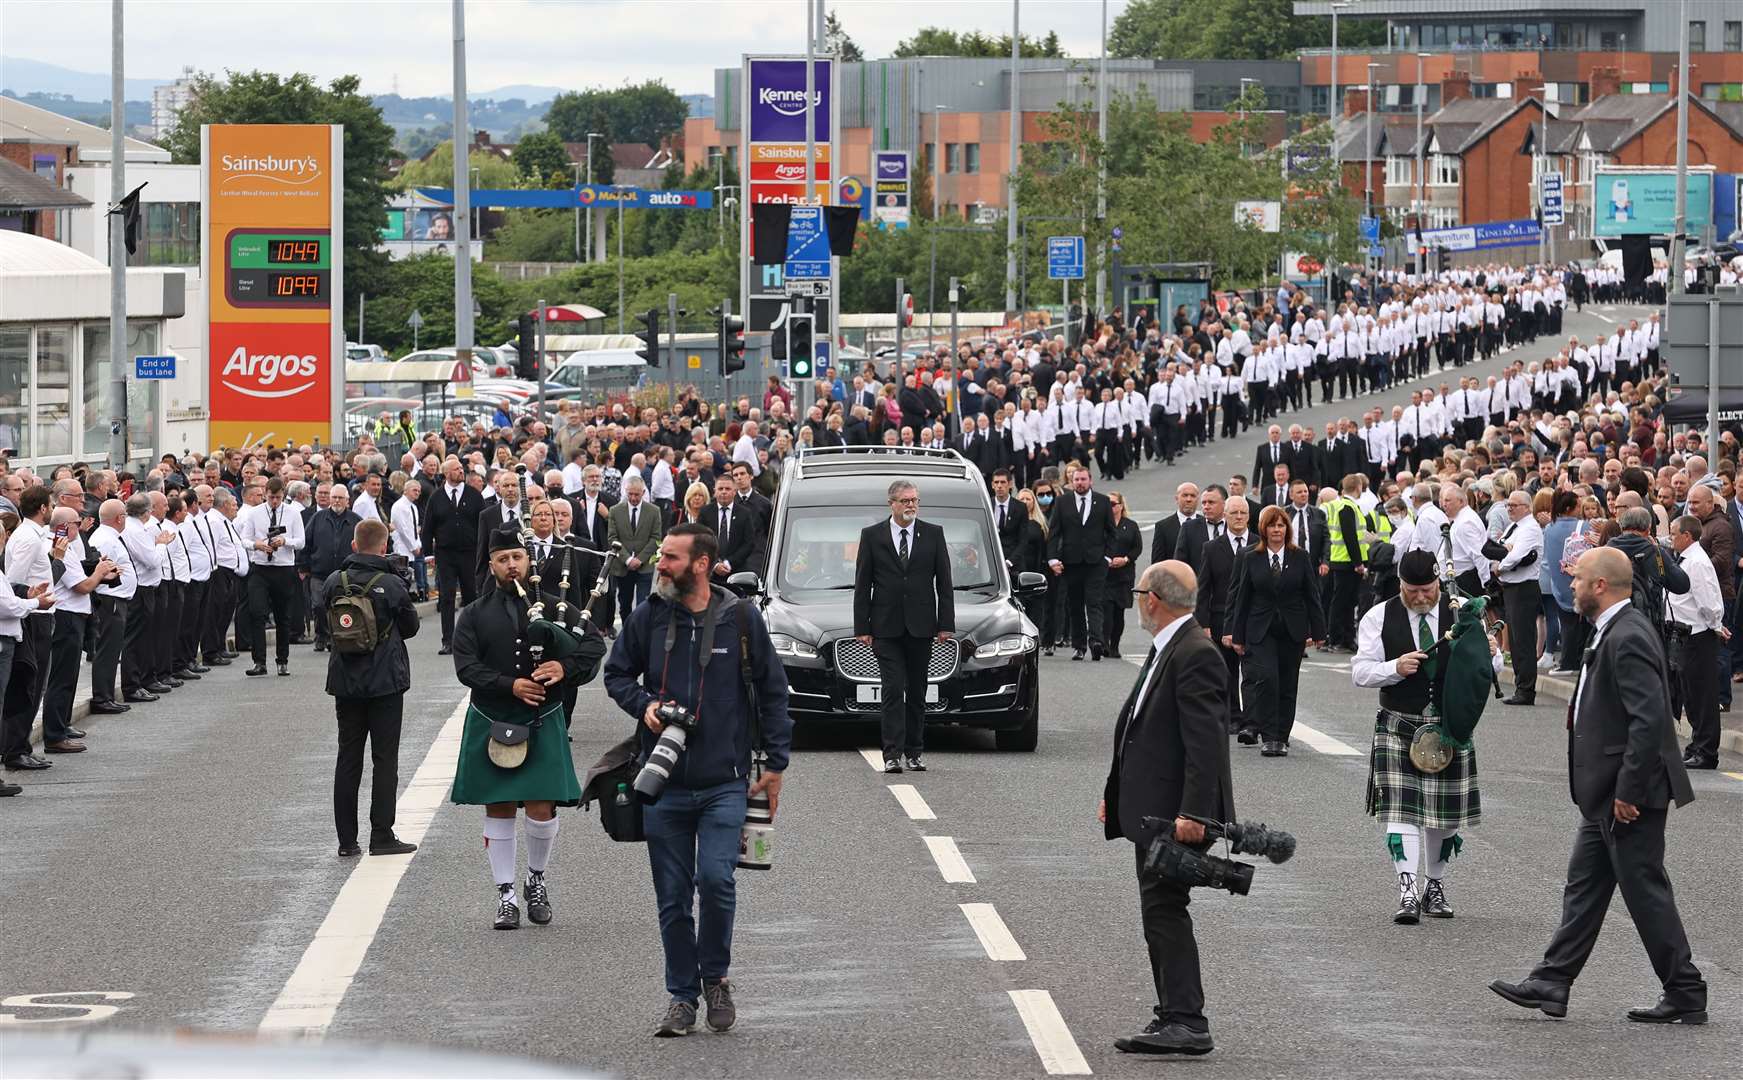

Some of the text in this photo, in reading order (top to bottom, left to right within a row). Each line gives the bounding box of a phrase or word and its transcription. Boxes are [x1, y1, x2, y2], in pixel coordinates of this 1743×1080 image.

[222, 155, 317, 175] Sainsbury's
[775, 164, 805, 176] Argos
[650, 192, 697, 206] auto24
[142, 359, 169, 368] End of
[222, 347, 317, 385] Argos
[139, 368, 173, 376] bus lane
